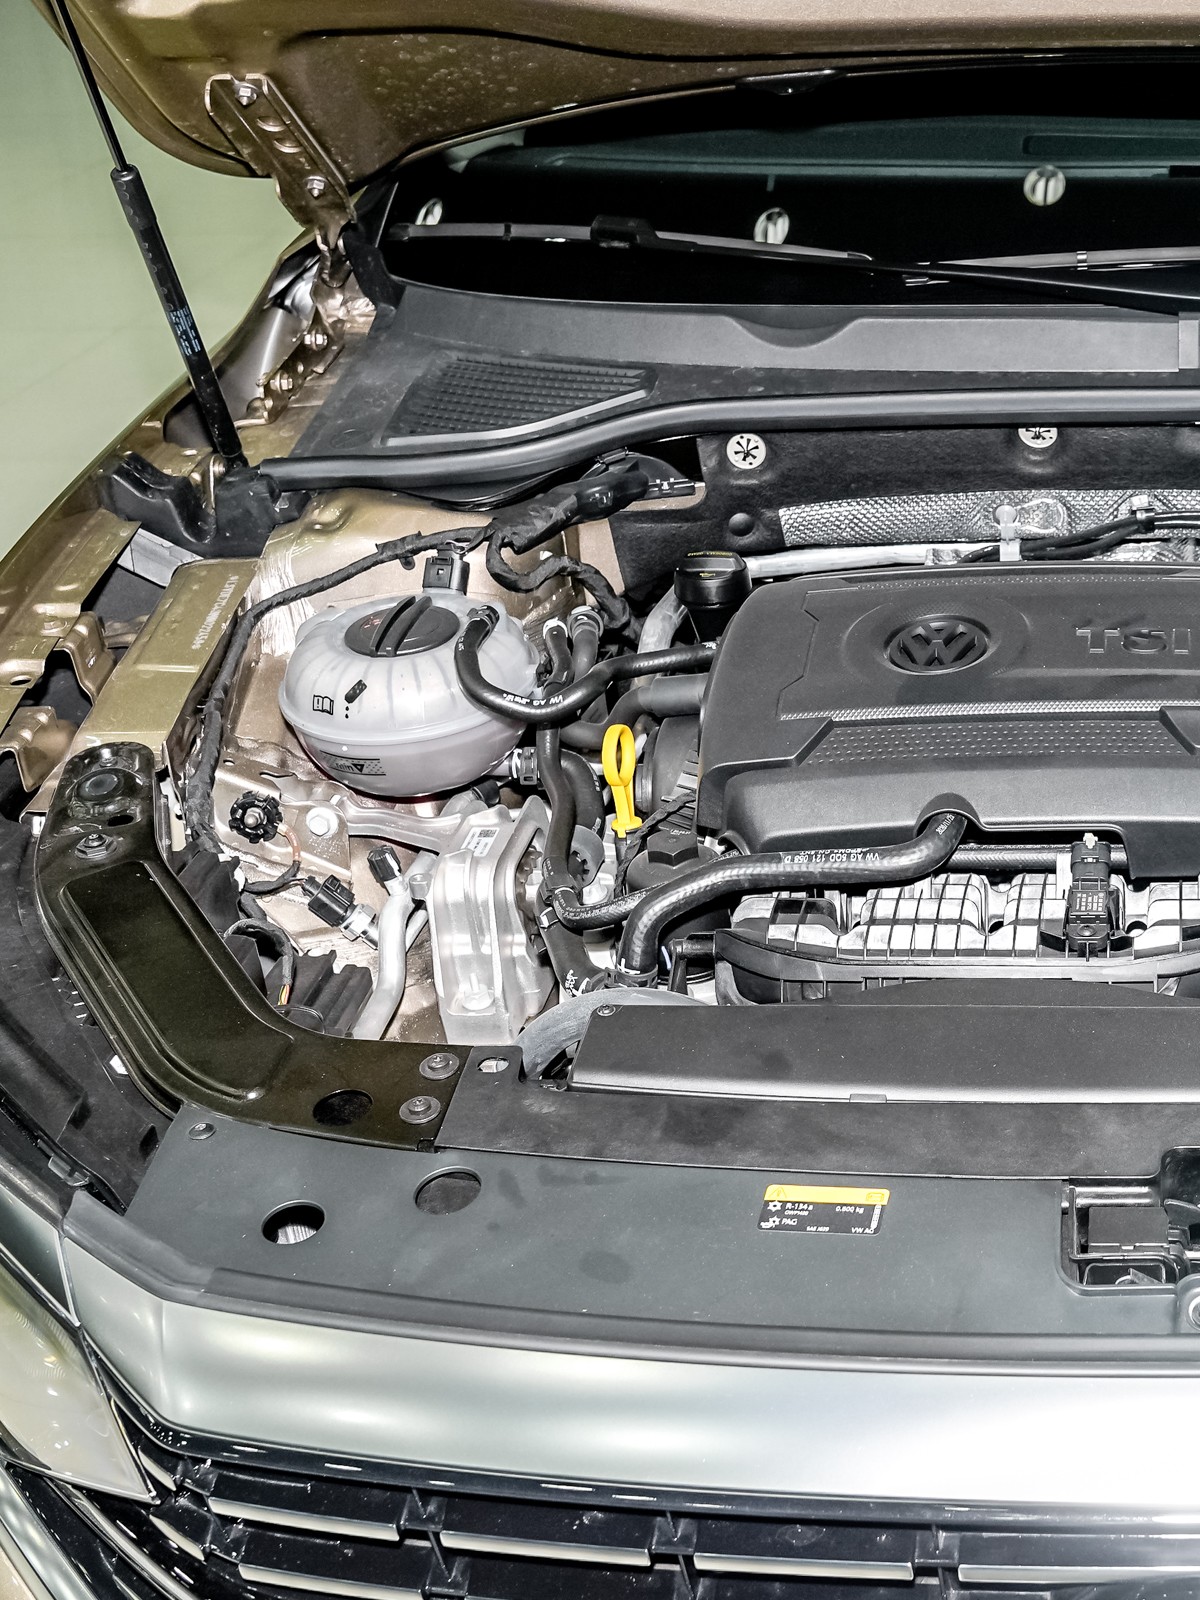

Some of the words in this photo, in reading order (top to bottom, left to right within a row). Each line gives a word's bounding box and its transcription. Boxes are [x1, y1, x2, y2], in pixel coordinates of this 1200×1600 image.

[1075, 627, 1191, 655] TSI
[811, 854, 826, 863] 121
[850, 853, 863, 862] AG
[865, 852, 880, 862] VW
[781, 1217, 798, 1226] PAG
